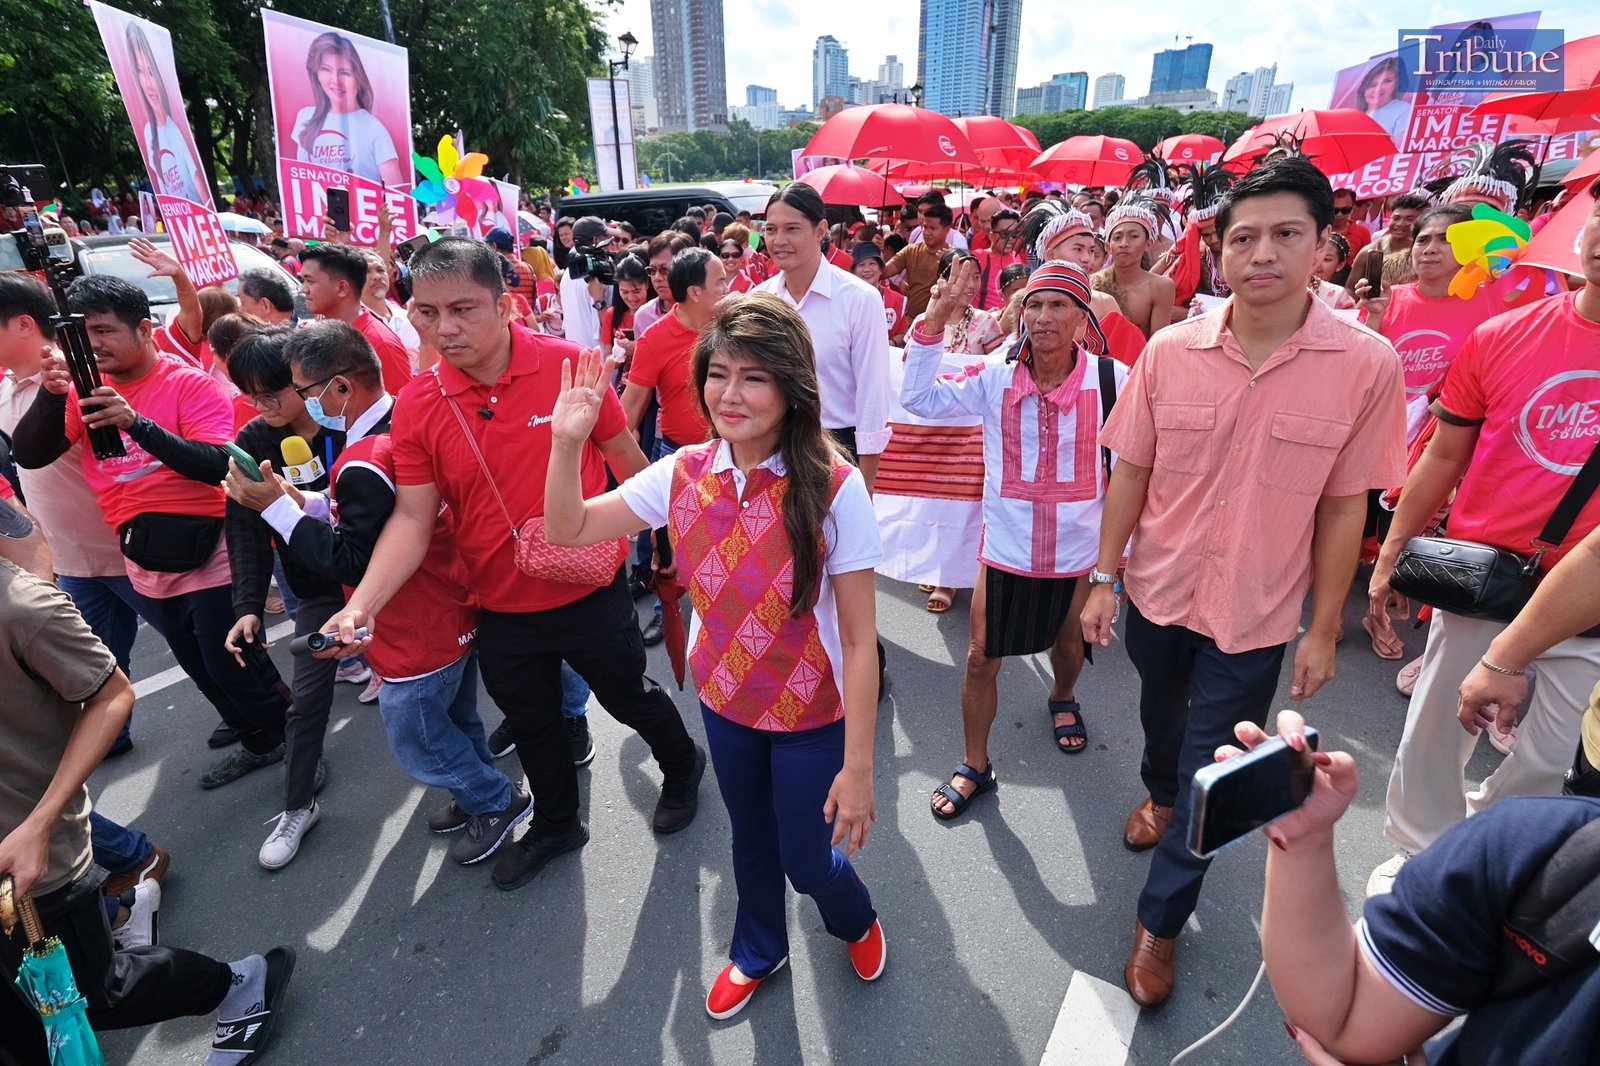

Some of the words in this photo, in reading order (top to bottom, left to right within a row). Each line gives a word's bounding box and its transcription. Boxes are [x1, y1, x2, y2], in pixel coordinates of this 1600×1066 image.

[1416, 106, 1459, 117] SENATOR
[1411, 113, 1499, 139] IMEE
[314, 144, 346, 158] IMEE
[290, 166, 350, 186] SENATOR
[1329, 153, 1413, 189] MEE
[161, 202, 192, 217] SENATOR
[166, 213, 228, 262] IMEE
[182, 252, 236, 287] MARCOS
[1535, 400, 1600, 429] IME
[1549, 421, 1600, 443] solus
[457, 626, 479, 646] MAT
[216, 1025, 235, 1037] NIKE
